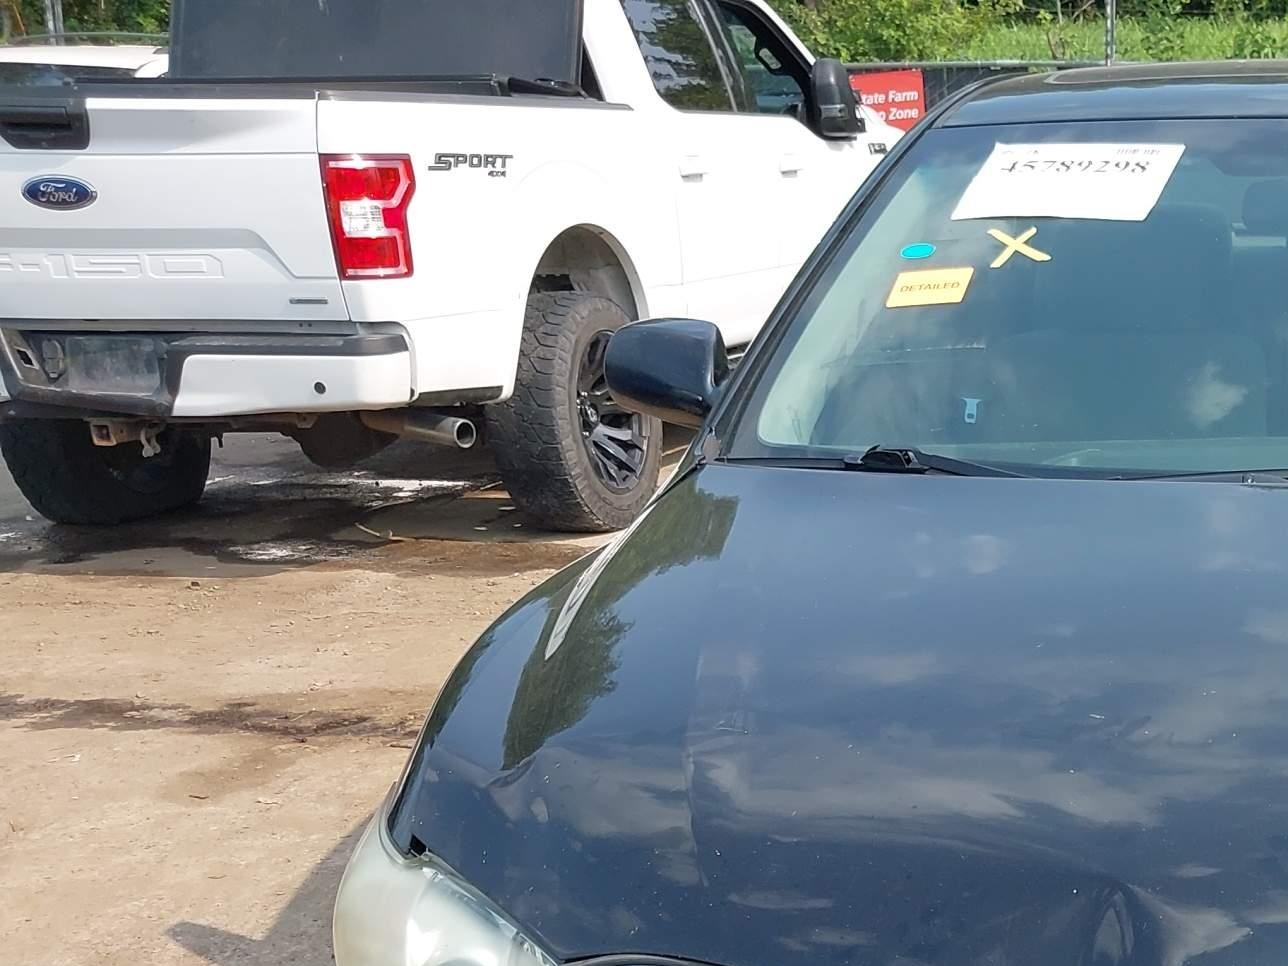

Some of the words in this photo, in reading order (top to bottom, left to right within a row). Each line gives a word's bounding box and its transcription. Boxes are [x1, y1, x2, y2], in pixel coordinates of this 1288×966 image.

[861, 92, 886, 105] tate
[888, 90, 919, 103] Farm
[888, 107, 919, 121] Zone
[427, 152, 514, 171] SPORT
[1000, 160, 1150, 173] 45789298
[38, 182, 78, 202] Ford
[900, 280, 961, 293] DETAILED
